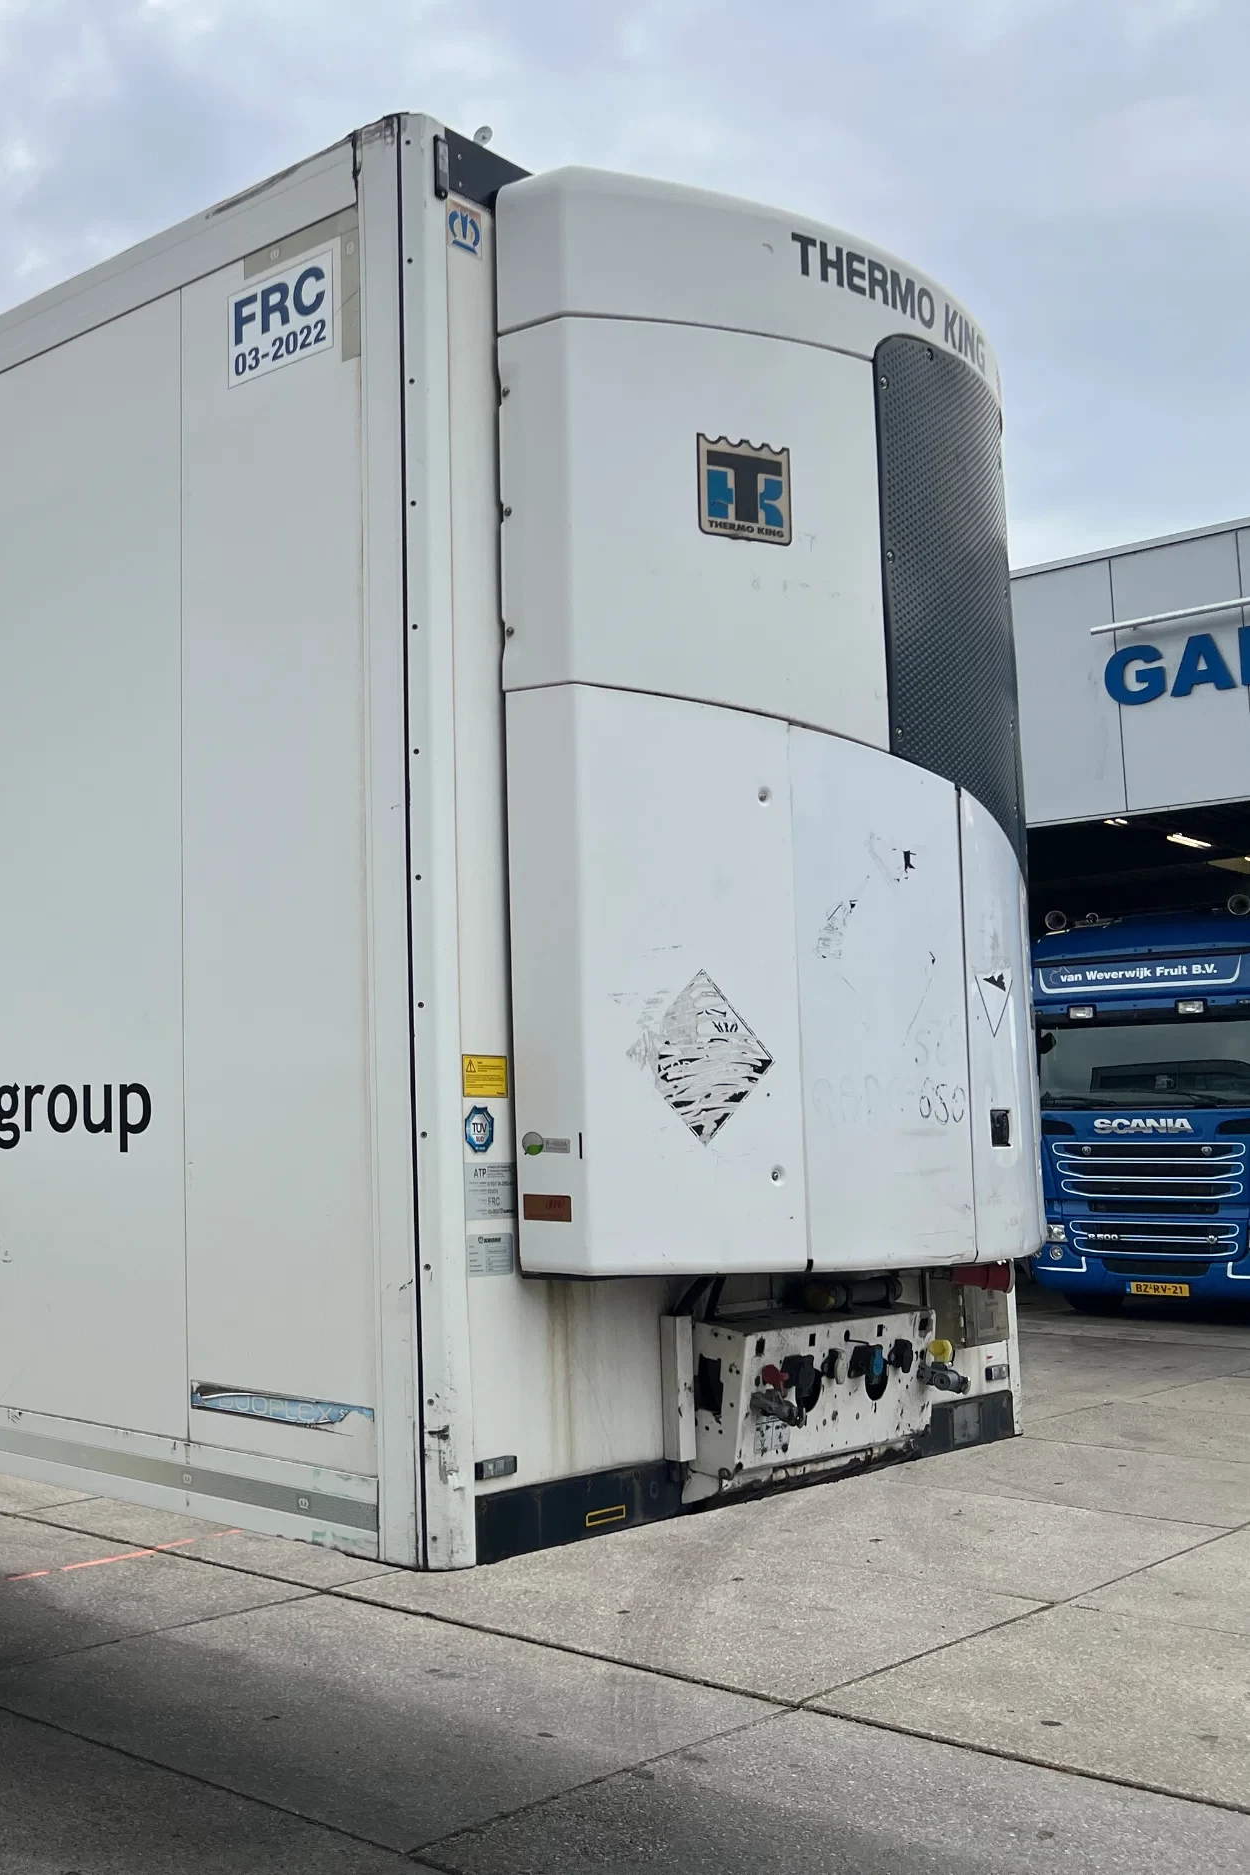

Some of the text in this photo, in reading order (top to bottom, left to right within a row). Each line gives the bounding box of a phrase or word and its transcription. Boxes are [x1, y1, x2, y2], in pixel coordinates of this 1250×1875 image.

[234, 266, 326, 346] FRC
[791, 231, 986, 375] THERMO KING
[234, 319, 327, 377] 03-2022
[708, 519, 785, 538] THERMO KING
[1060, 963, 1218, 982] van Weverwijk Fruit B.V.
[1093, 1118, 1194, 1134] SCANIA
[473, 1168, 487, 1178] ATP
[487, 1196, 501, 1206] FRC
[1135, 1283, 1183, 1295] BZ-RV-21
